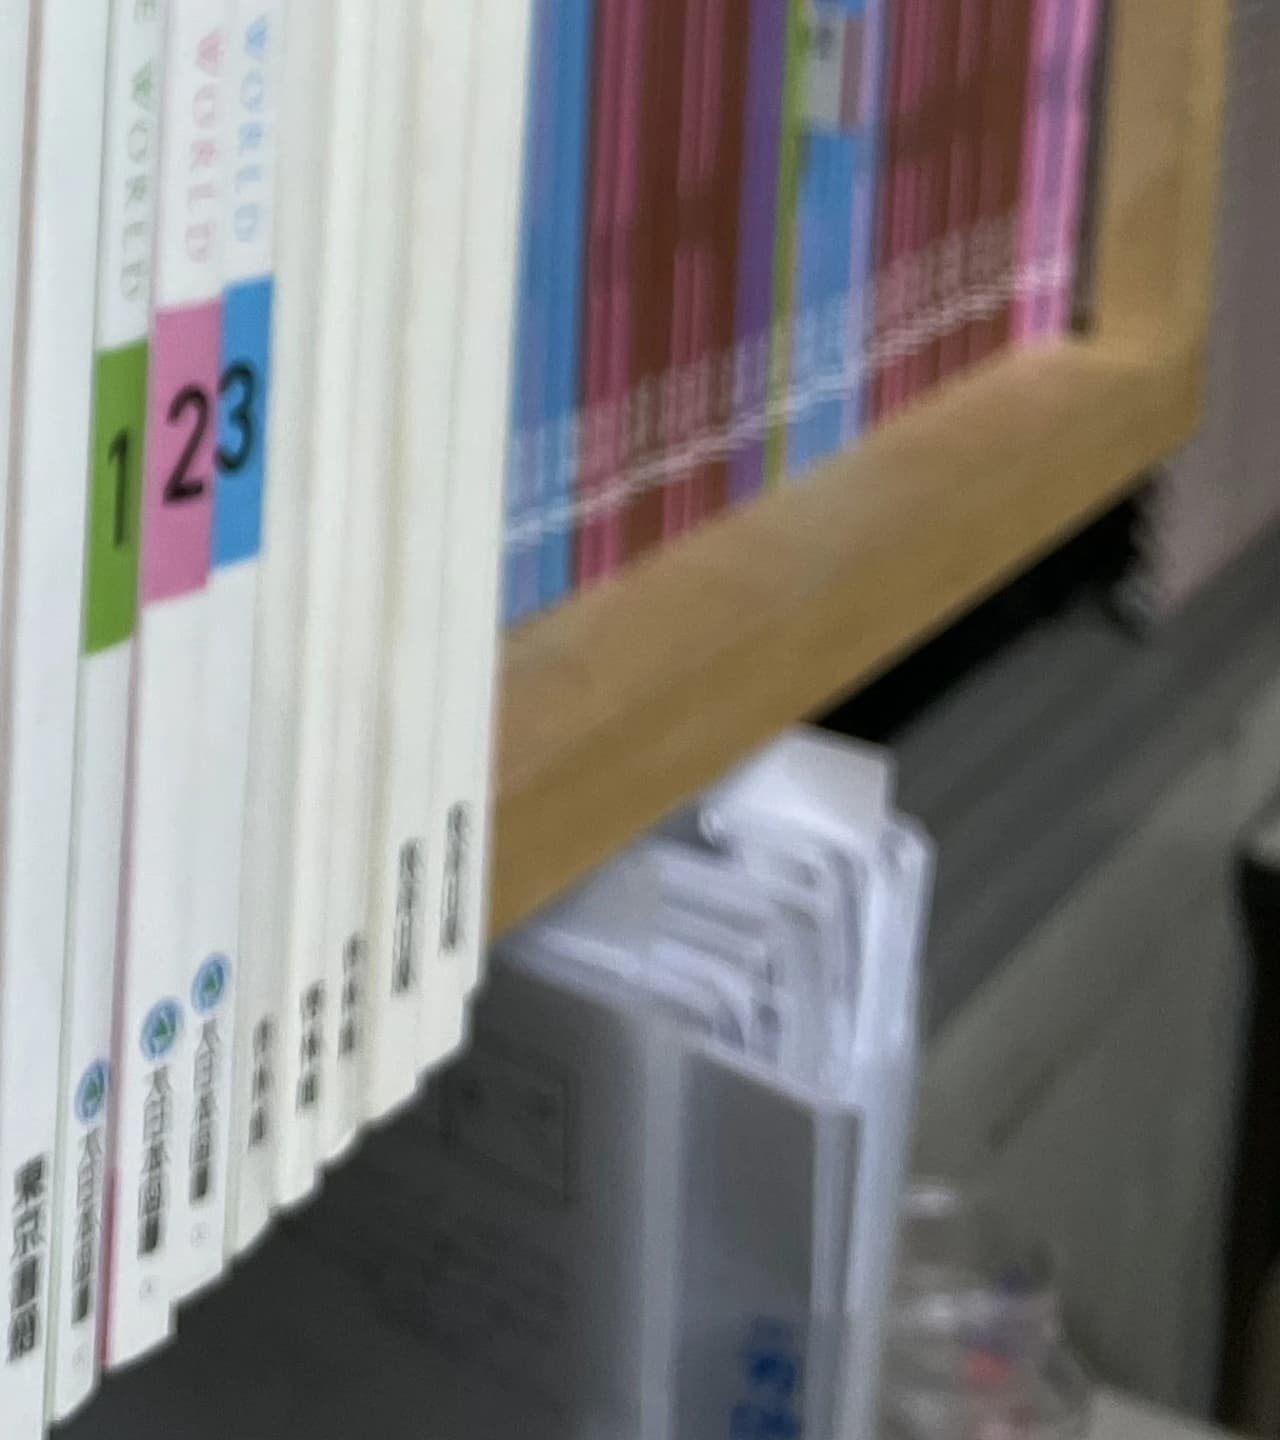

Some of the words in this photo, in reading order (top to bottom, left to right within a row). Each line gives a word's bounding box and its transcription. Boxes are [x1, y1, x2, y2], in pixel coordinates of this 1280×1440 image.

[162, 382, 211, 505] 2
[216, 360, 256, 476] 3
[107, 427, 131, 550] 1
